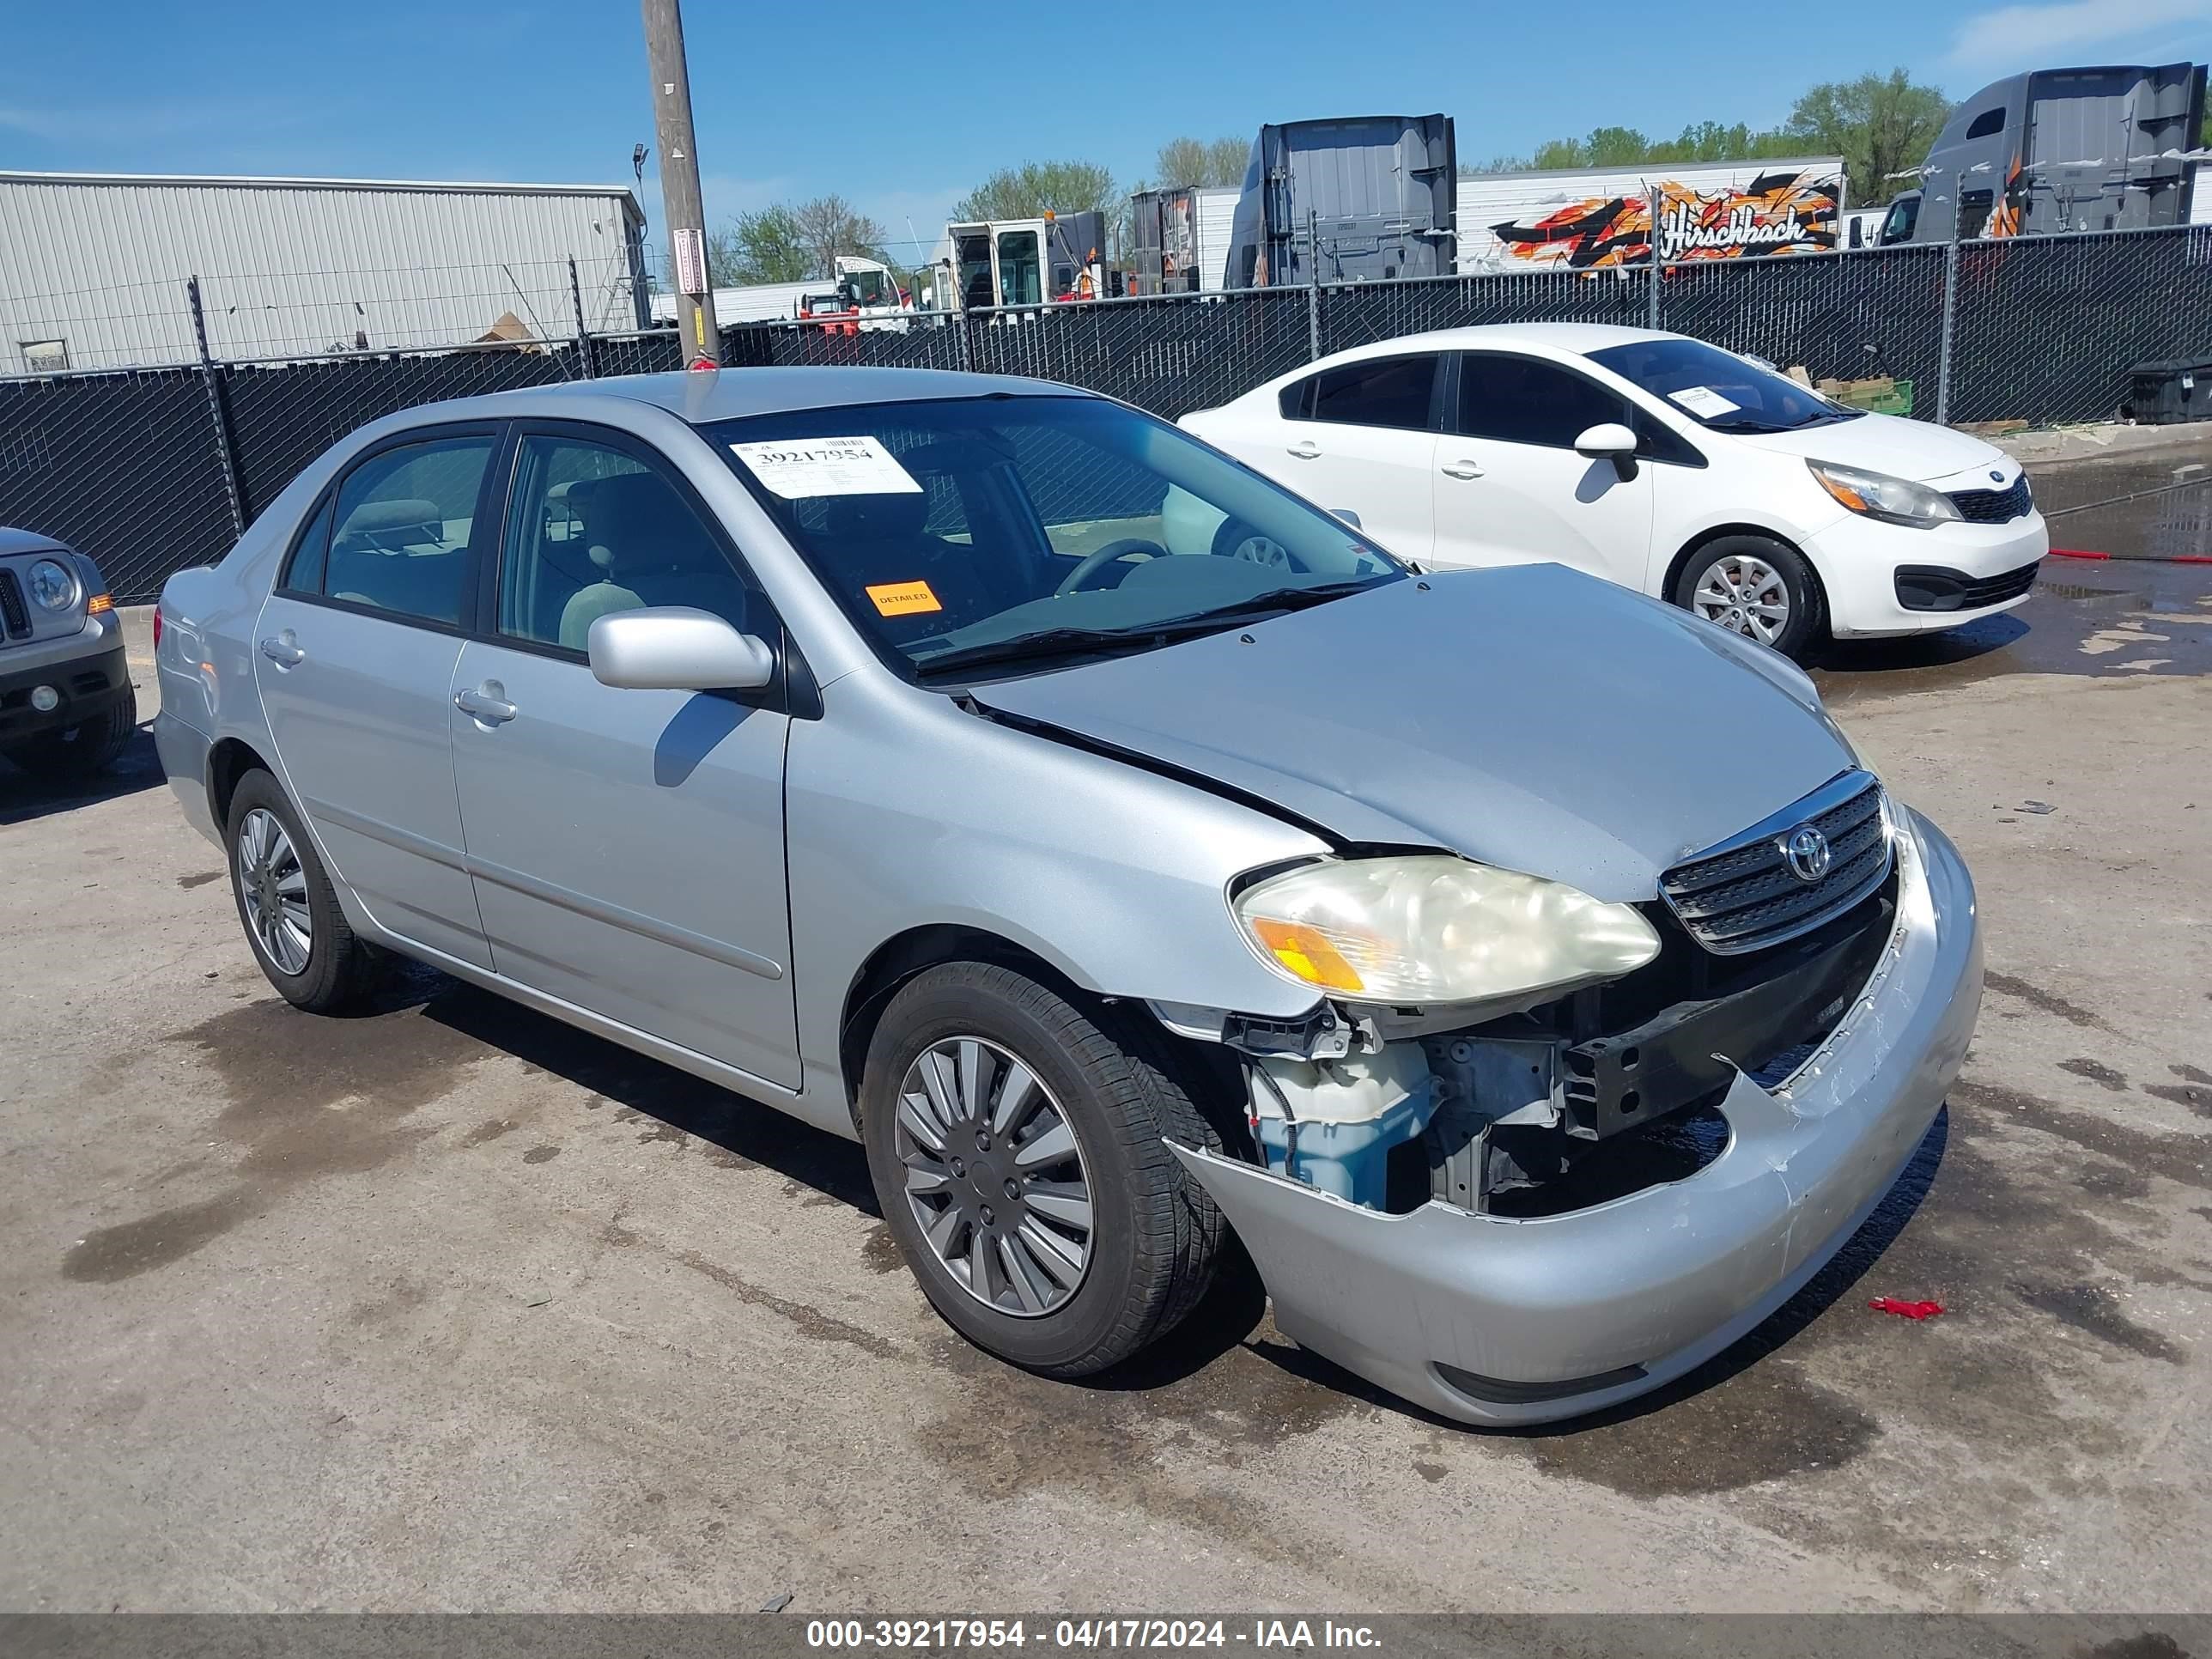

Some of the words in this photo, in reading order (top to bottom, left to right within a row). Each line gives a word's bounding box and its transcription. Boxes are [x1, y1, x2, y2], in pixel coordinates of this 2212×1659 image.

[1662, 199, 1806, 258] Hirschbach
[756, 449, 872, 465] 39217954
[879, 592, 928, 604] DETAILED
